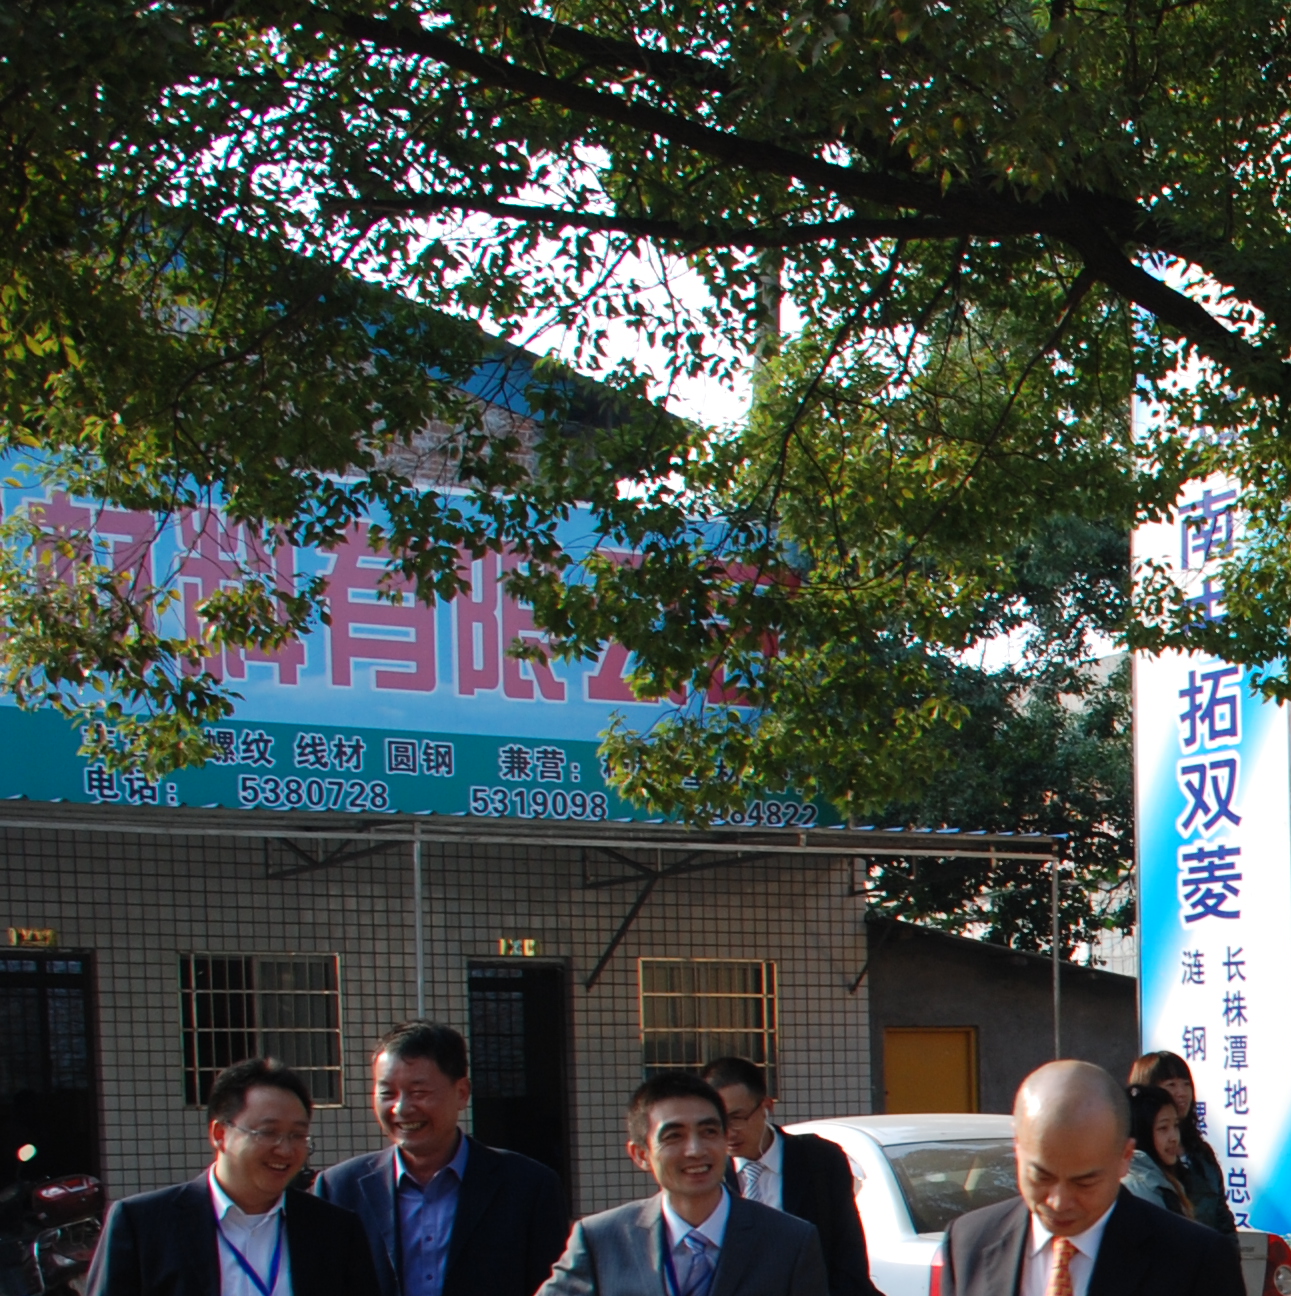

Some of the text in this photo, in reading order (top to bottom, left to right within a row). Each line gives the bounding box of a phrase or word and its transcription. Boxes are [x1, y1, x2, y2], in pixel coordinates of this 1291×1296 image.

[294, 732, 365, 771] 线材
[386, 738, 453, 777] 圆钢
[239, 775, 389, 810] 5380728
[470, 786, 608, 820] 5319098
[693, 799, 819, 825] 4822
